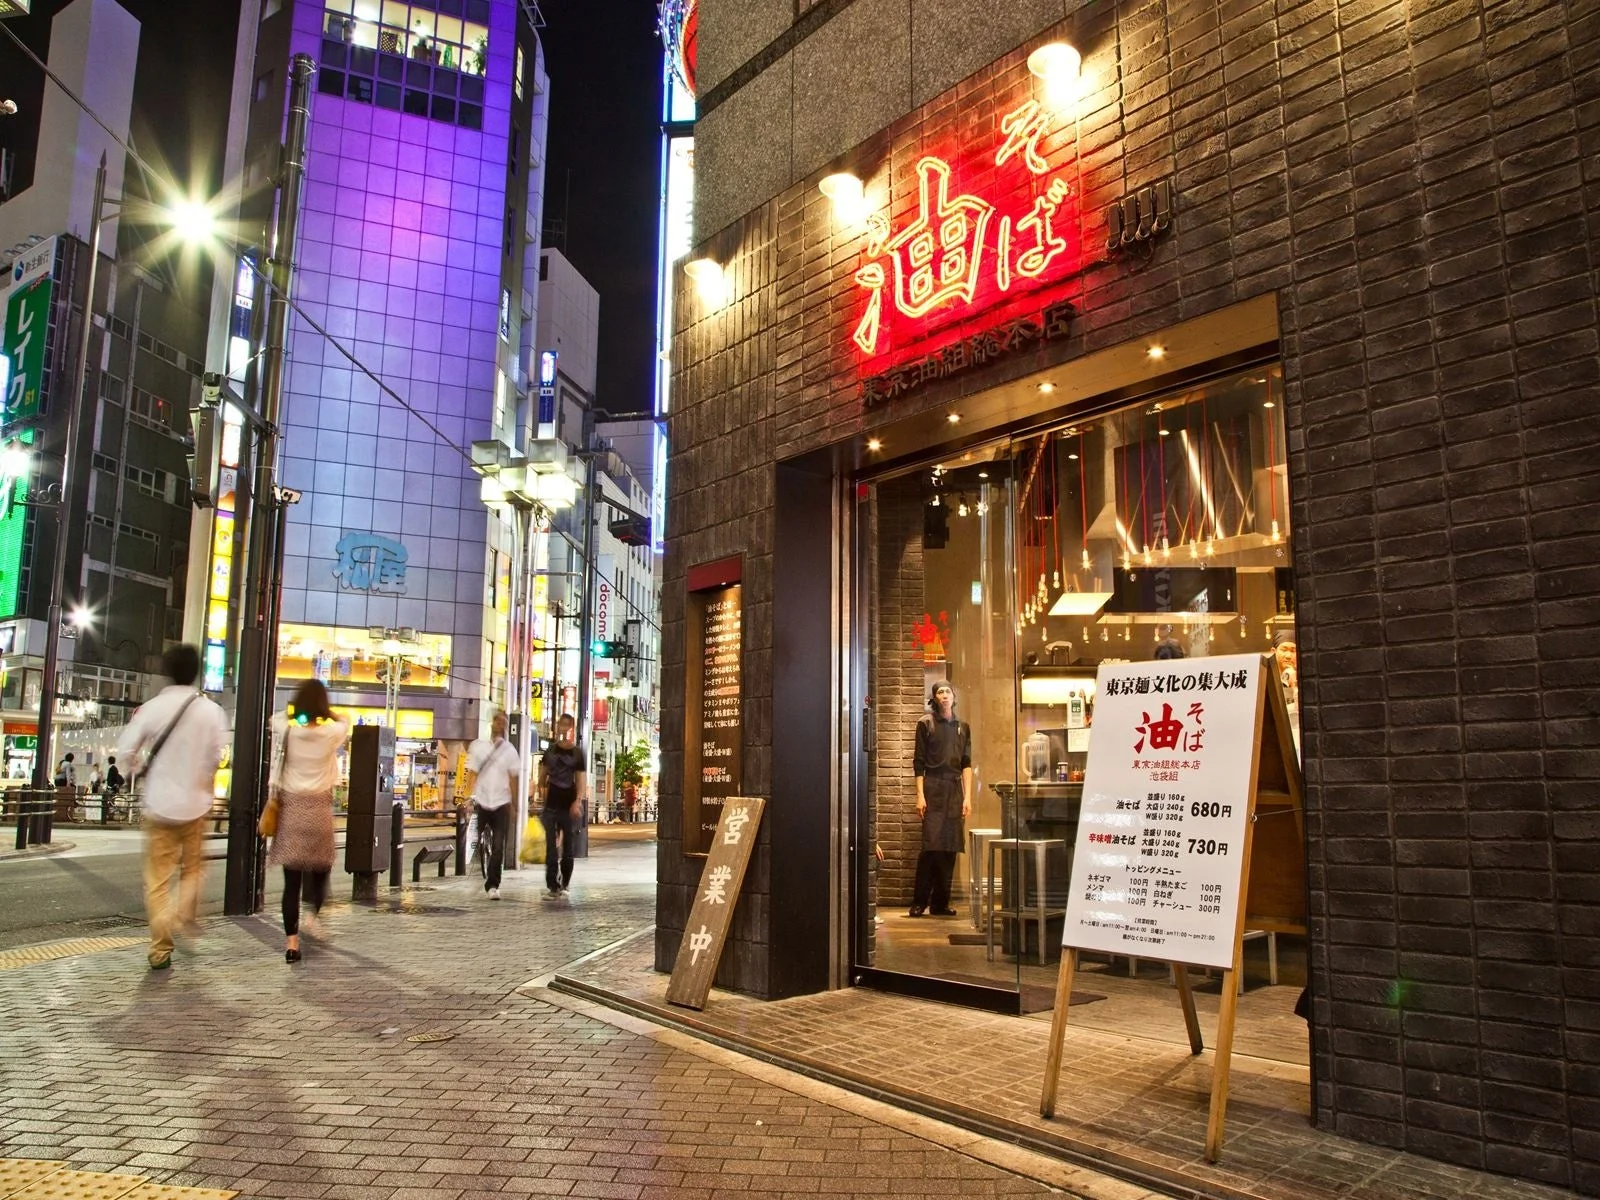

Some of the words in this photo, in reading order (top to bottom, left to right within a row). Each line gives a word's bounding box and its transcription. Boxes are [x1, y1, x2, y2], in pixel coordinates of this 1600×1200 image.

[9, 299, 34, 408] レイク
[862, 302, 1078, 406] 東京油組総本店
[331, 531, 408, 594] 松屋
[1131, 760, 1201, 770] 東京油組総本店
[1149, 771, 1179, 781] 池袋組
[1147, 793, 1165, 801] 並盛り
[1168, 793, 1186, 802] 160g
[1116, 800, 1141, 810] 油そば
[1146, 802, 1165, 811] 大盛り
[1166, 803, 1184, 812] 240g
[1191, 802, 1232, 818] 680円
[1146, 812, 1164, 821] W盛り
[1165, 813, 1183, 822] 320g
[1143, 828, 1162, 837] 並盛り
[1164, 829, 1182, 838] 160g
[1141, 838, 1160, 847] 大盛り
[1162, 839, 1180, 848] 240g
[1187, 838, 1228, 856] 730円
[1141, 848, 1159, 857] W盛り
[1160, 849, 1179, 859] 320g
[1125, 864, 1182, 876] トッピングメニュー
[689, 806, 749, 967] 営業中
[1130, 878, 1149, 887] 100円
[1154, 880, 1188, 891] 半熟たまご
[1201, 884, 1222, 894] 100円
[1153, 890, 1174, 900] 白ねぎ
[1200, 894, 1221, 904] 100円
[1152, 899, 1192, 911] チャーシュー
[1198, 904, 1220, 914] 300円
